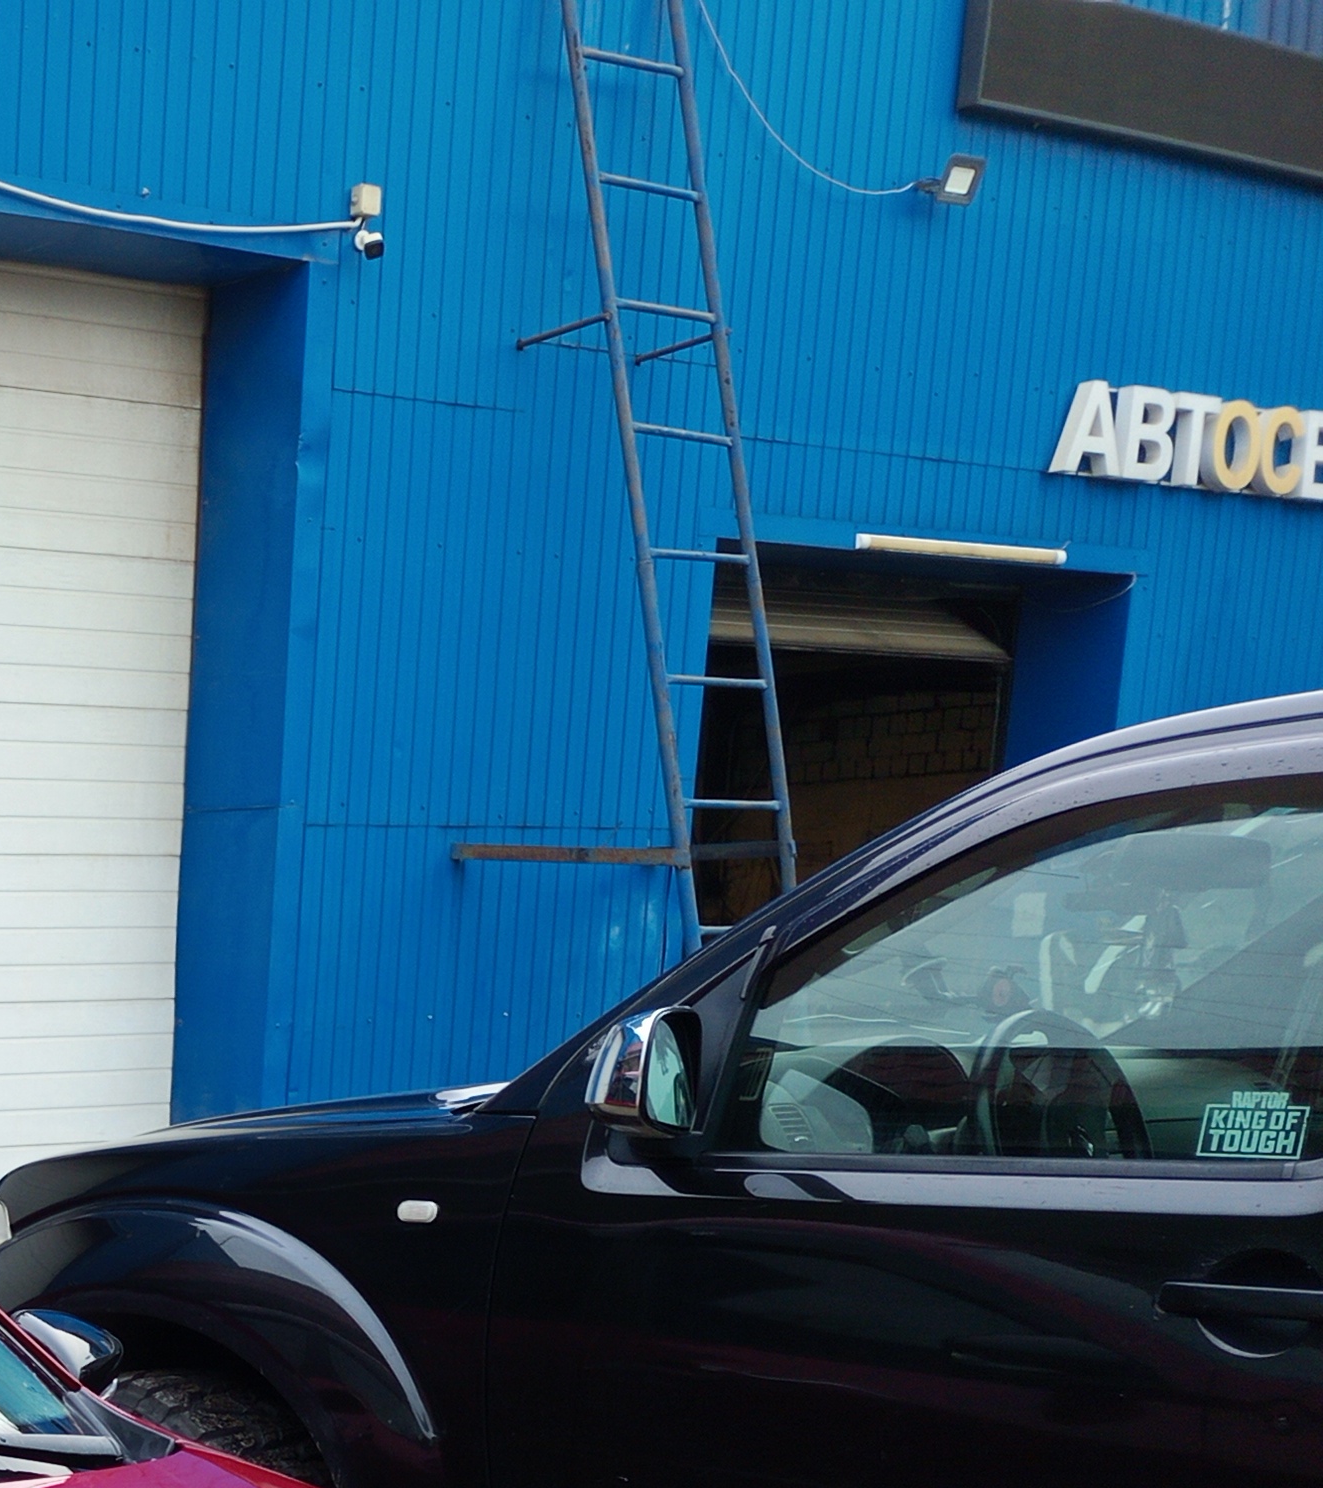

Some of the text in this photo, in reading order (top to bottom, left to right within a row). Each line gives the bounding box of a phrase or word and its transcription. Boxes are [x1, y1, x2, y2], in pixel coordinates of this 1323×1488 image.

[1232, 1091, 1290, 1109] RAPTOR
[1210, 1109, 1302, 1130] KING OF
[1209, 1129, 1298, 1154] TOUGH
